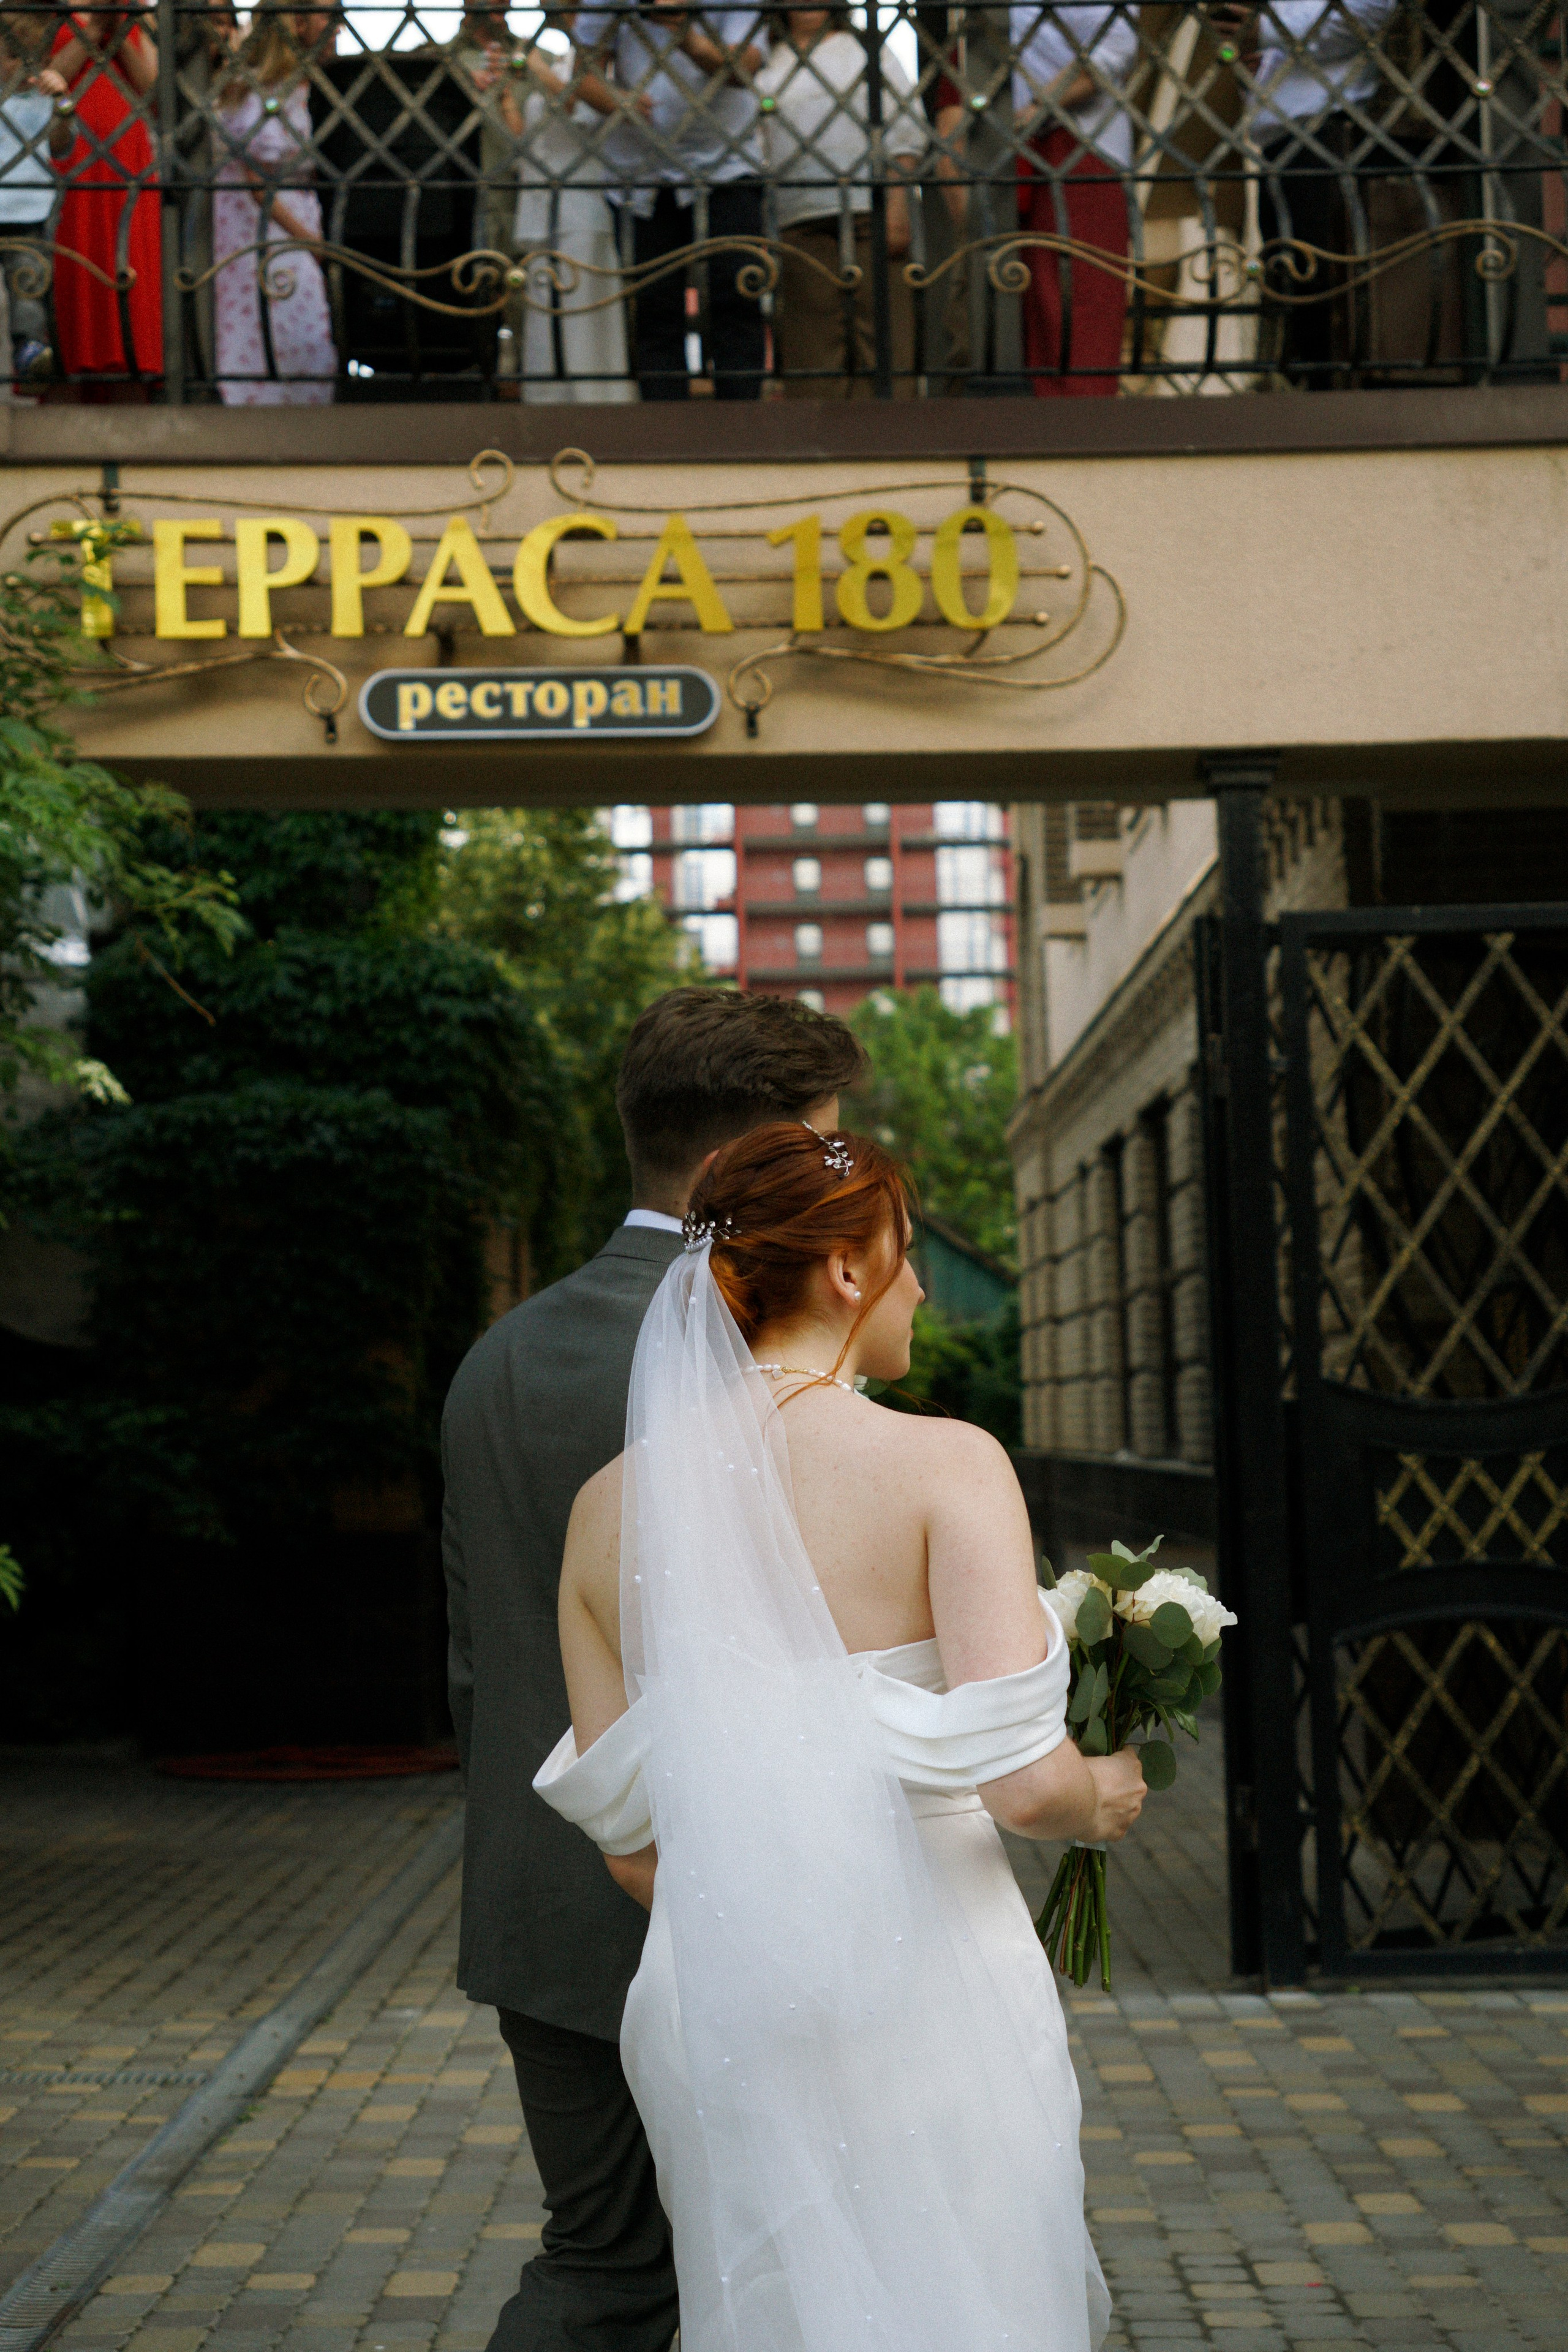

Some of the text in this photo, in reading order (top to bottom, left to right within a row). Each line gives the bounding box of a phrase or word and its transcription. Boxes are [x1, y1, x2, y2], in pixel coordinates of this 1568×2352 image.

[50, 506, 1019, 639] ТЕРРАСА 180
[397, 678, 683, 731] ресторан
